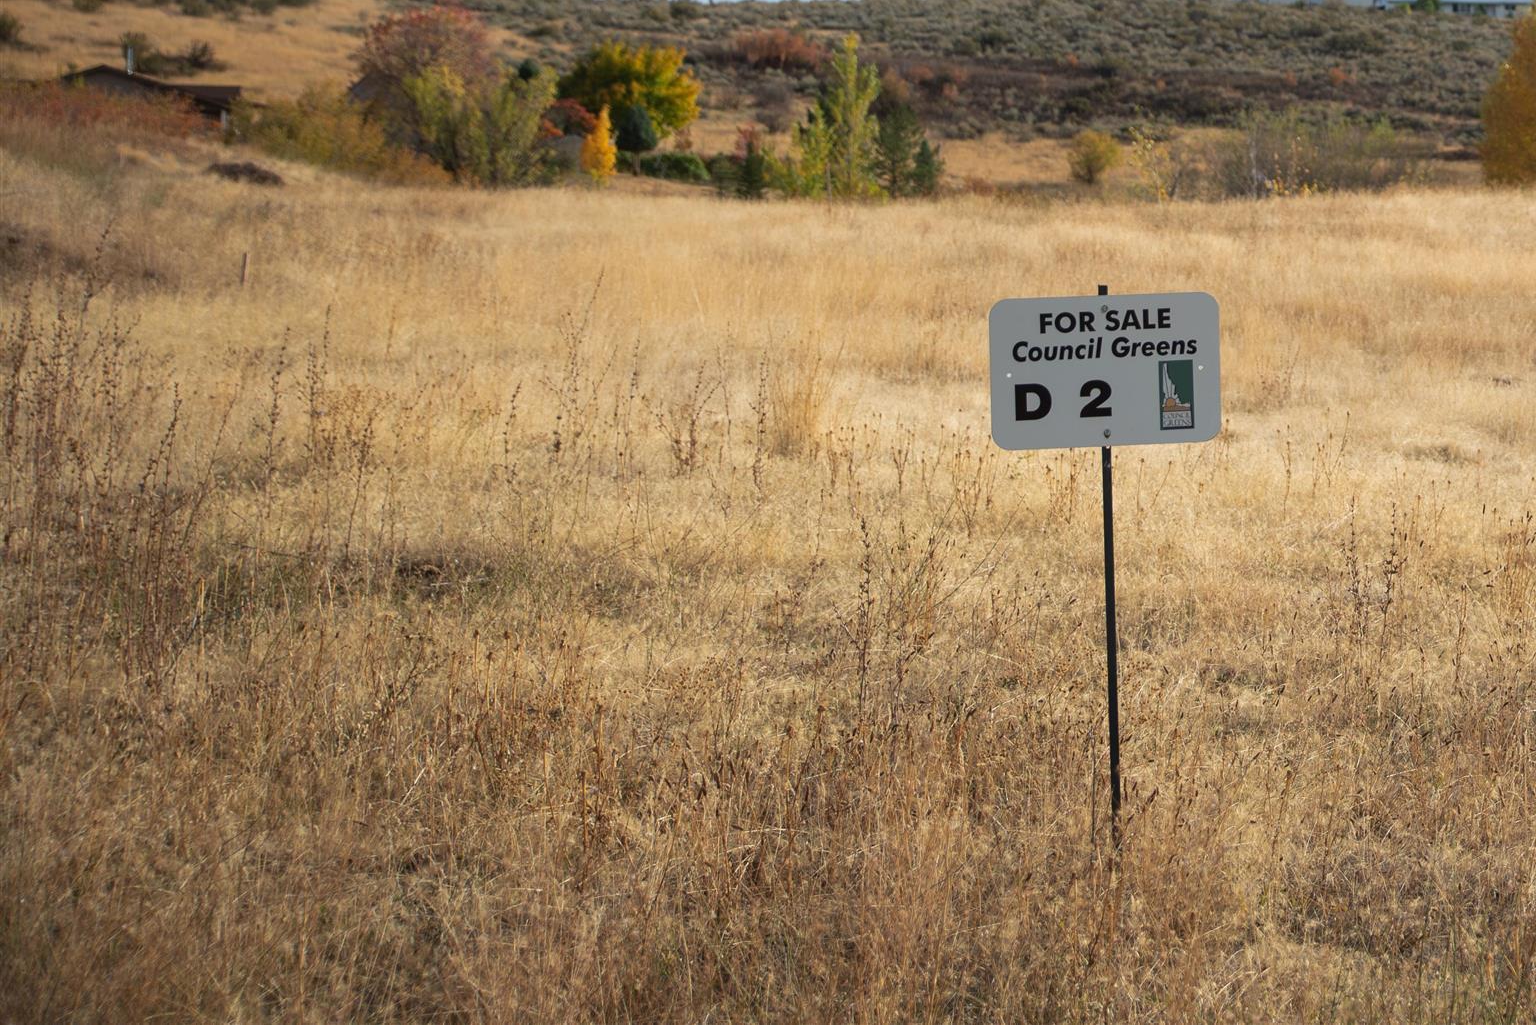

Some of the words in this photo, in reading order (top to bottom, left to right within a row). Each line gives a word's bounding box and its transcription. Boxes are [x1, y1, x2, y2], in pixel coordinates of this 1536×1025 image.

[1039, 311, 1096, 334] FOR
[1105, 308, 1171, 332] SALE
[1012, 337, 1103, 362] Council
[1111, 336, 1197, 358] Greens
[1014, 383, 1052, 421] D
[1079, 379, 1112, 418] 2
